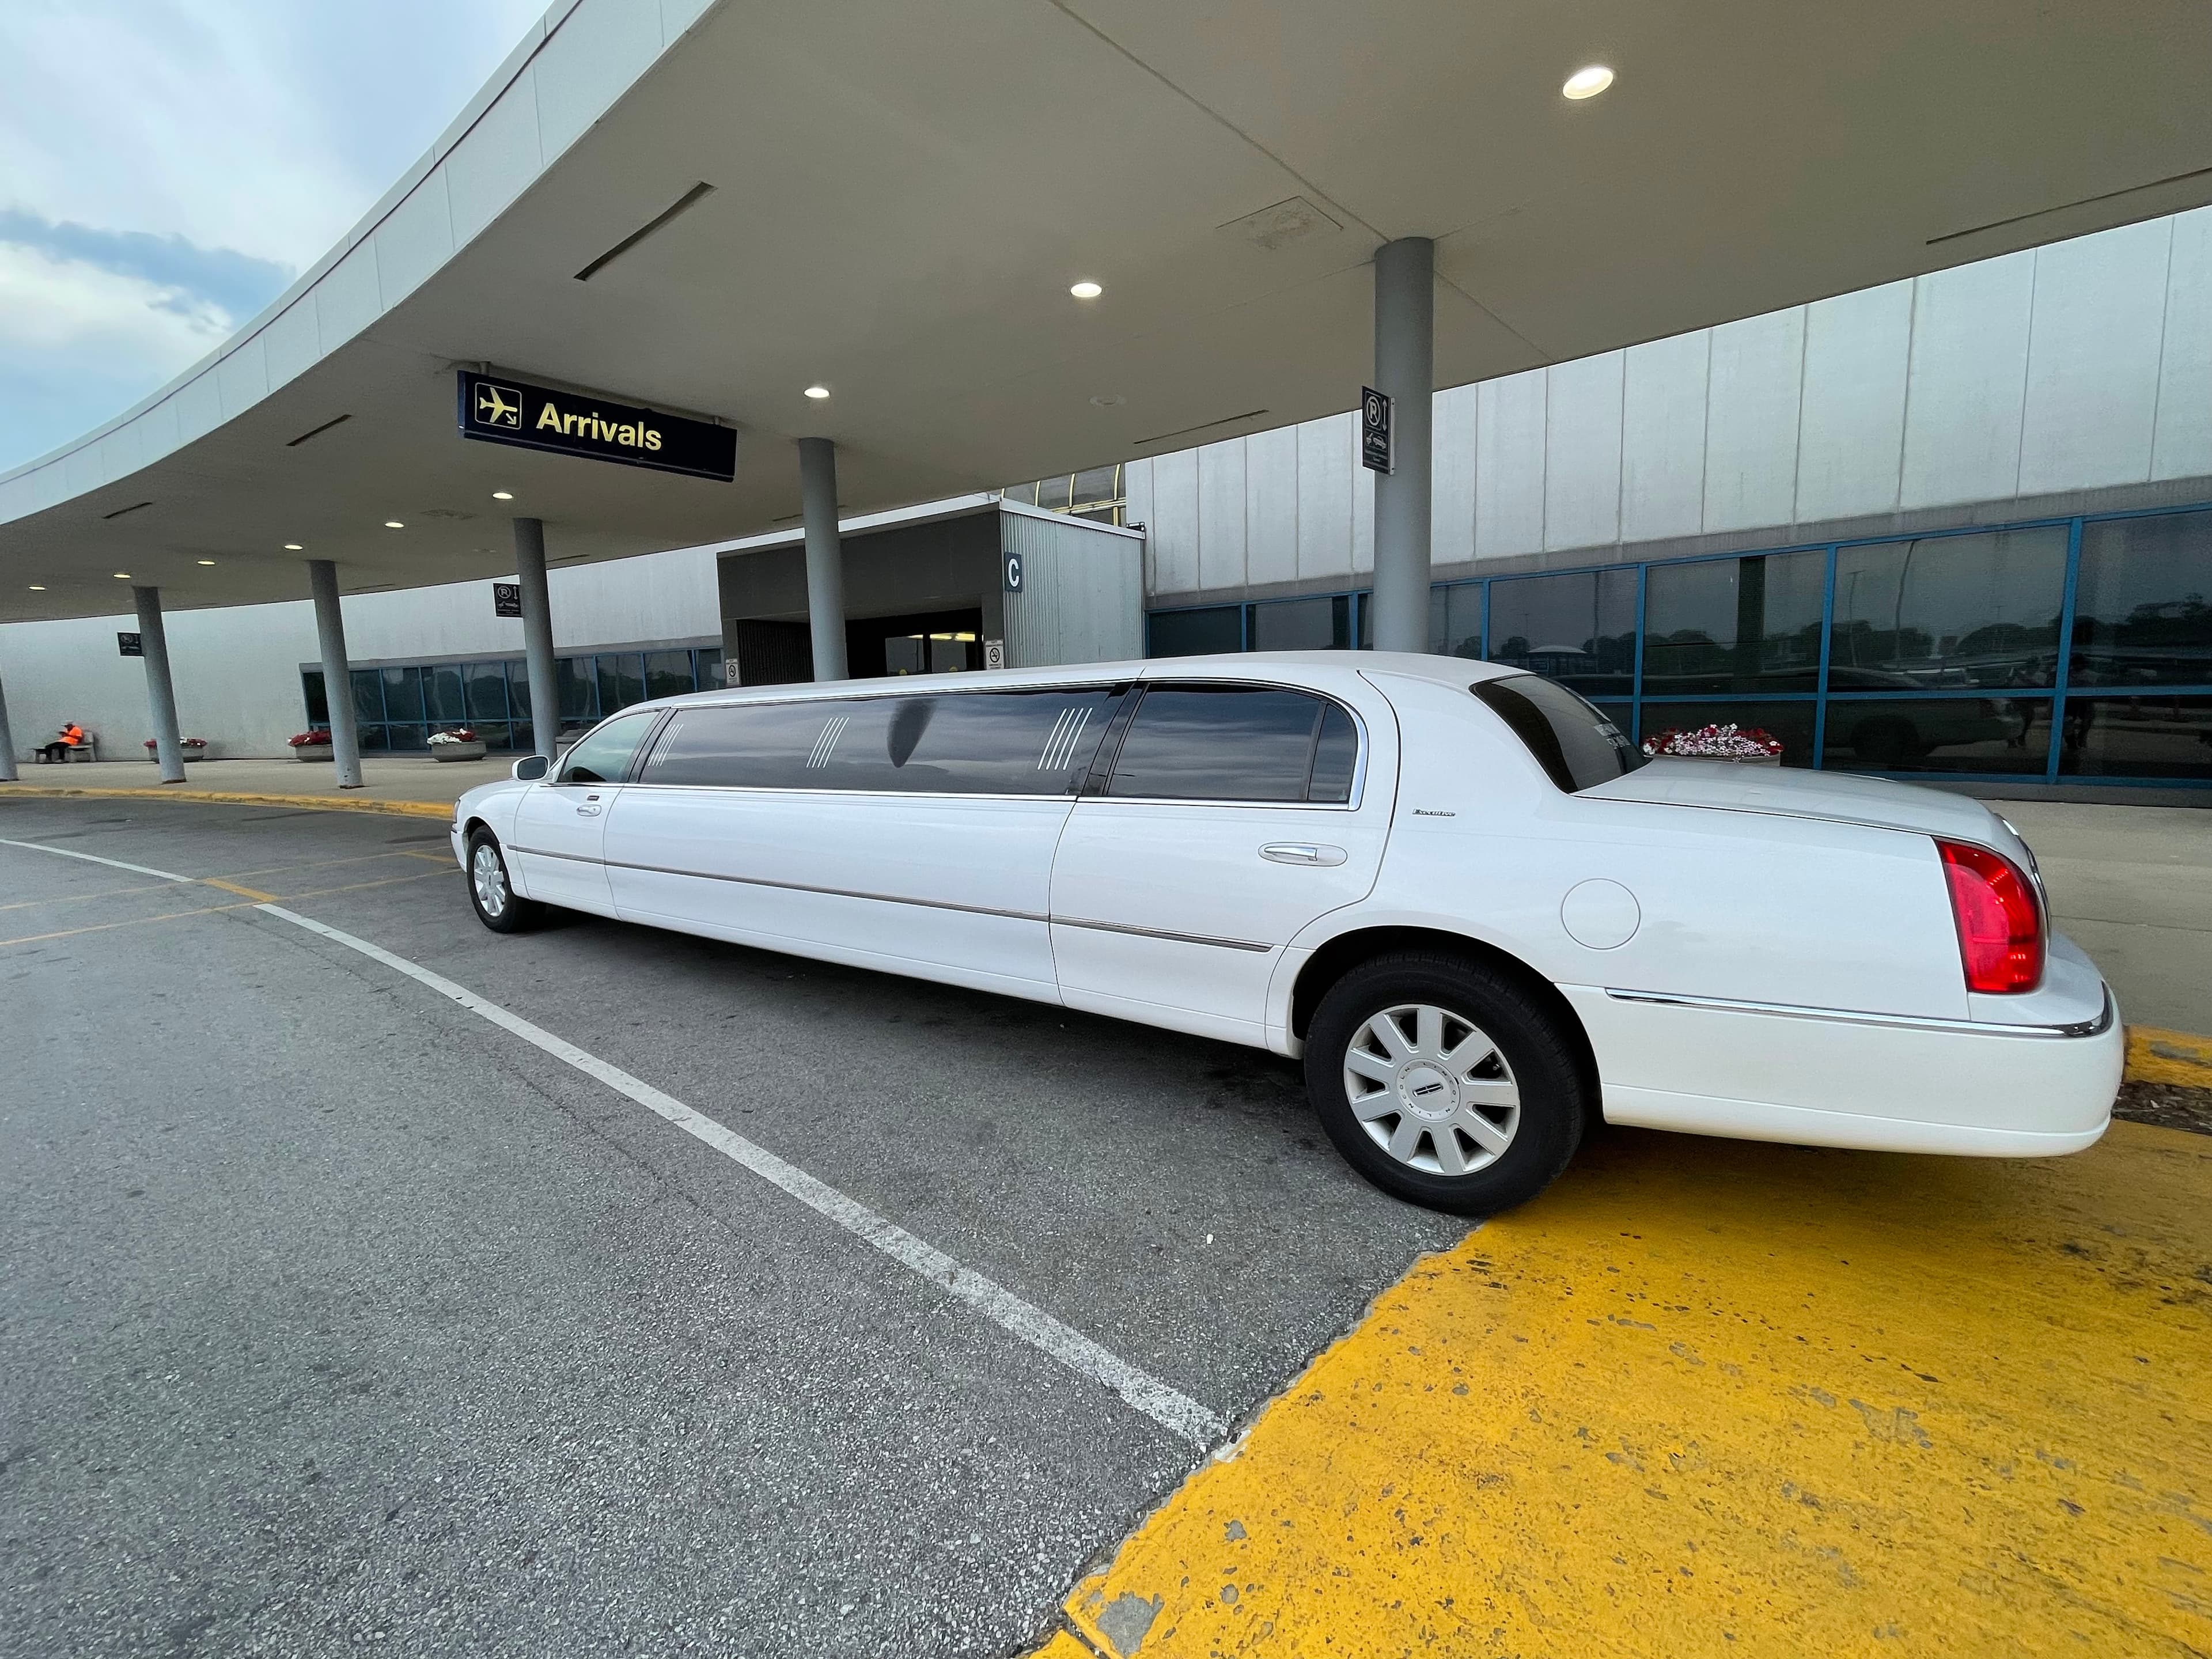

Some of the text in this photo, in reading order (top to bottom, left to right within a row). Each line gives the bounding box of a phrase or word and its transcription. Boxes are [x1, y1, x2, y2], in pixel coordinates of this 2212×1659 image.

[536, 403, 662, 450] Arrivals
[1008, 558, 1020, 587] C
[1412, 808, 1456, 817] Executive
